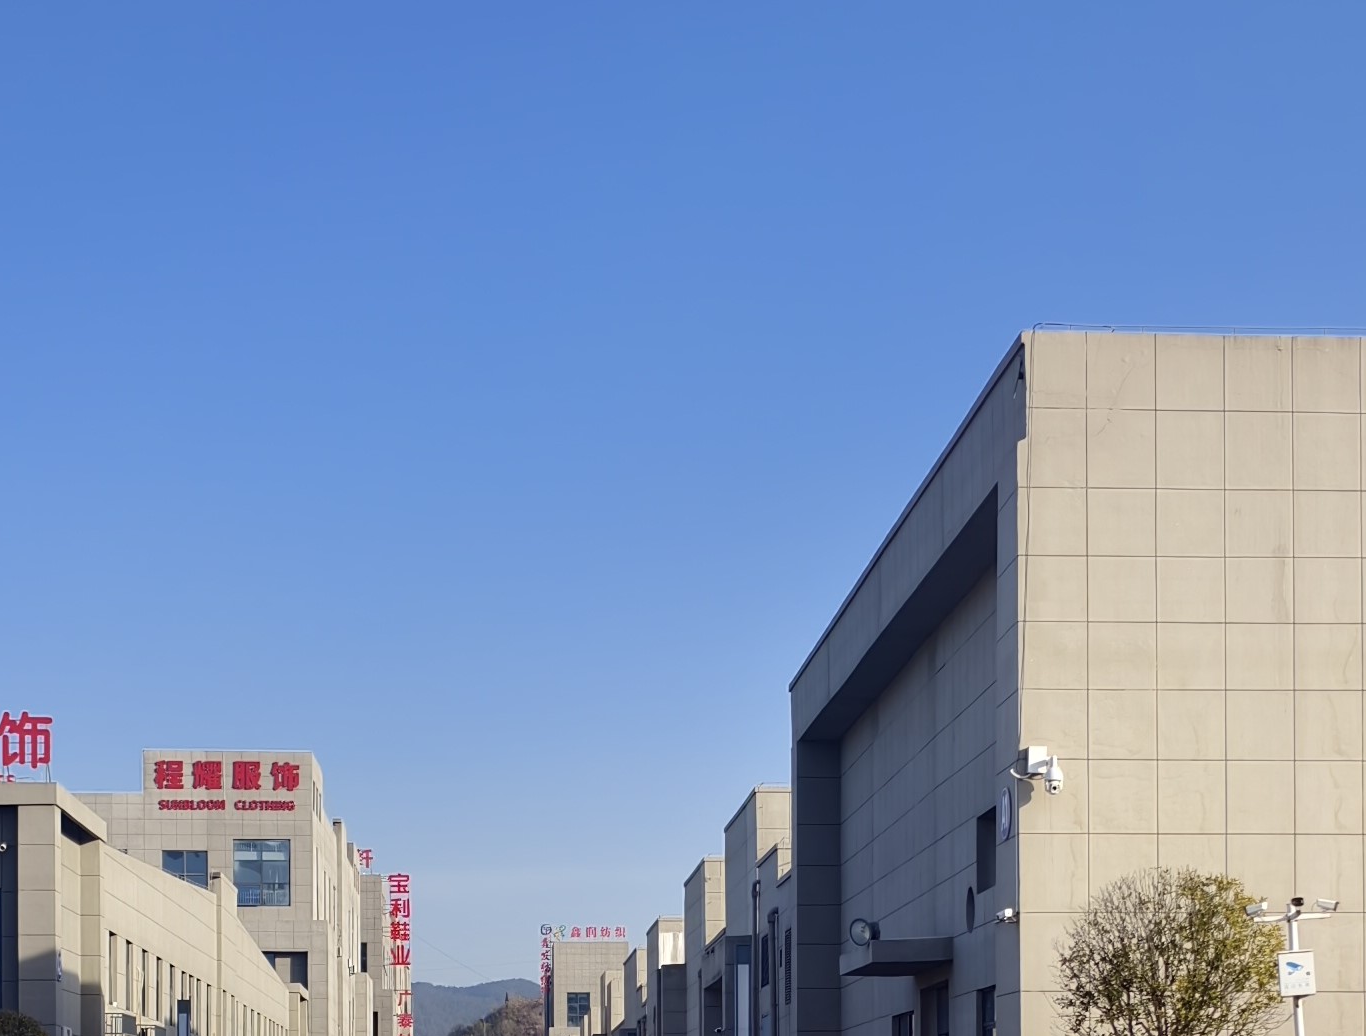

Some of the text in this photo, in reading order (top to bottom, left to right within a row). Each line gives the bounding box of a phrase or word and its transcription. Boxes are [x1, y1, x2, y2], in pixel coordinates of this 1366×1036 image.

[153, 760, 300, 791] 程耀服饰
[388, 873, 411, 966] 宝利鞋业
